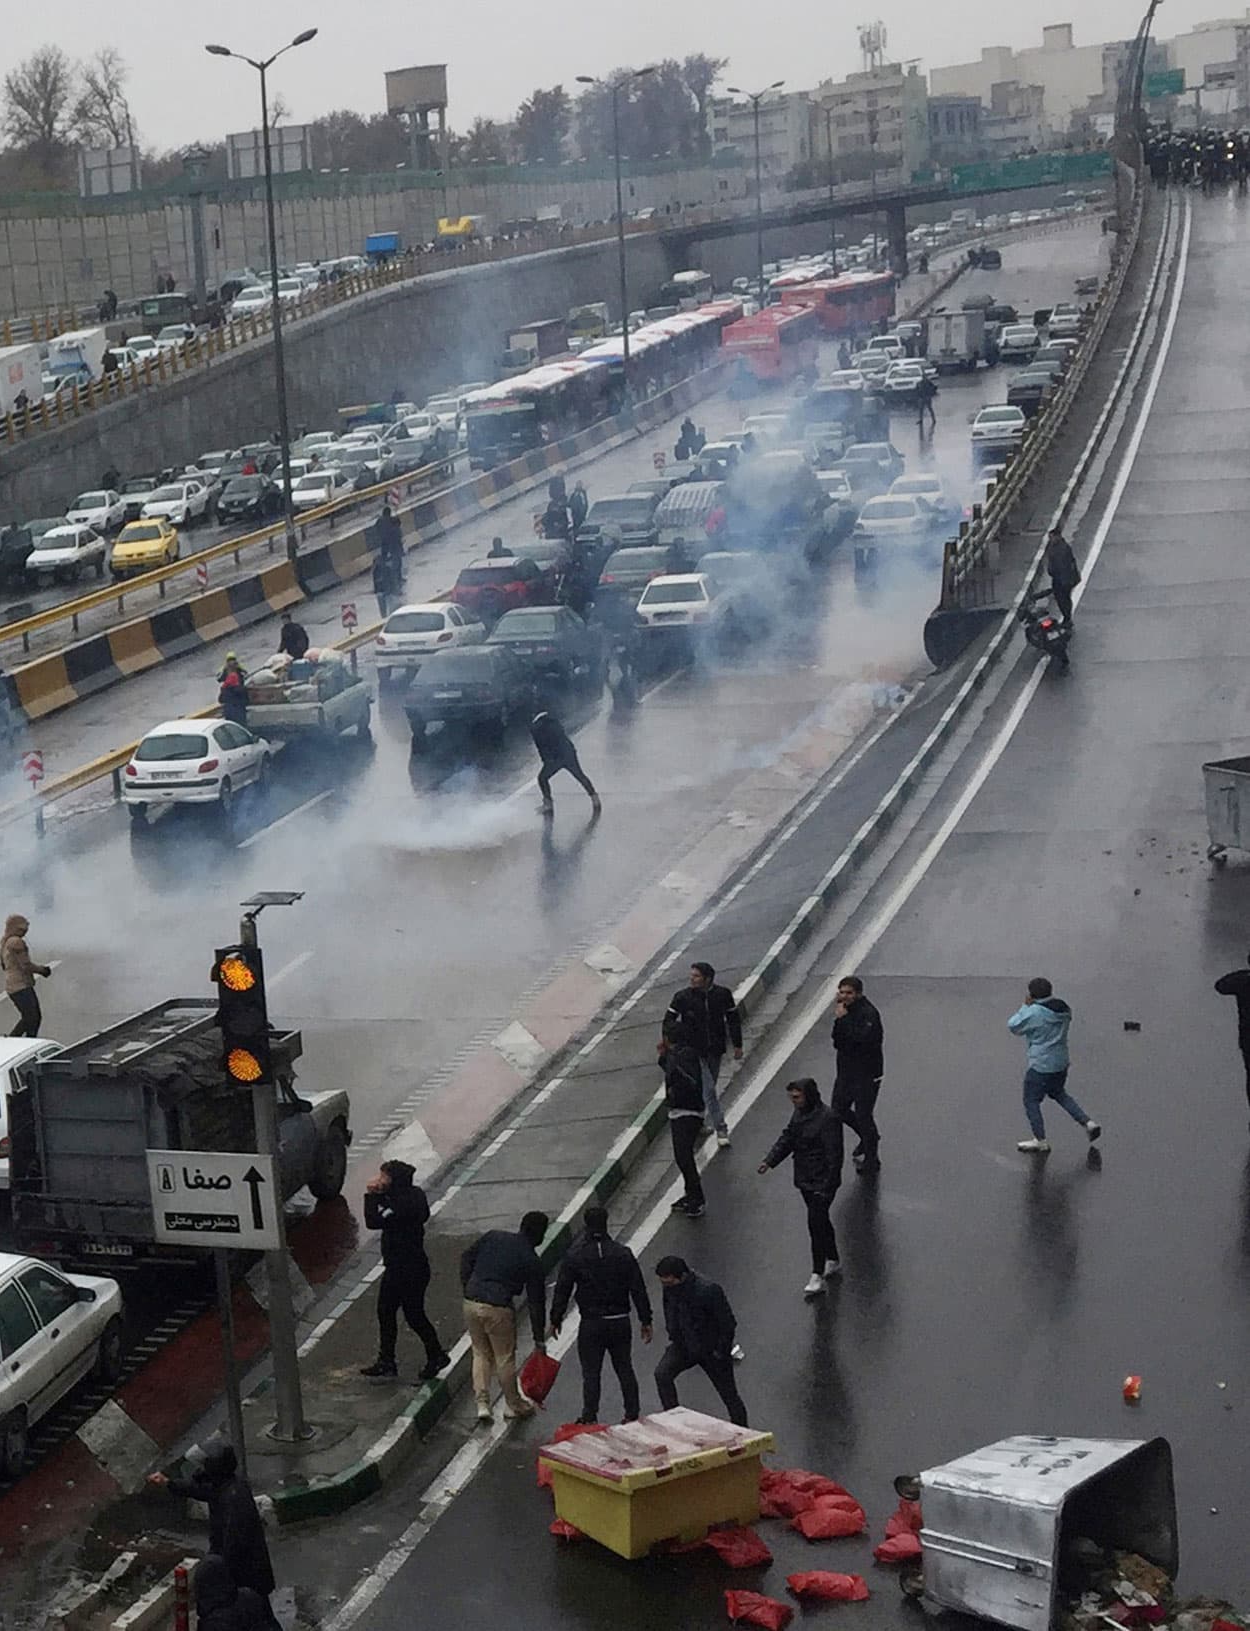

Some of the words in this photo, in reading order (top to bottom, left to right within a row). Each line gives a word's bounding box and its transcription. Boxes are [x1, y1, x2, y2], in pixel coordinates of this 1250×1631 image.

[182, 1167, 232, 1190] صفا
[167, 1215, 192, 1228] محلی
[194, 1216, 238, 1229] دسترسی
